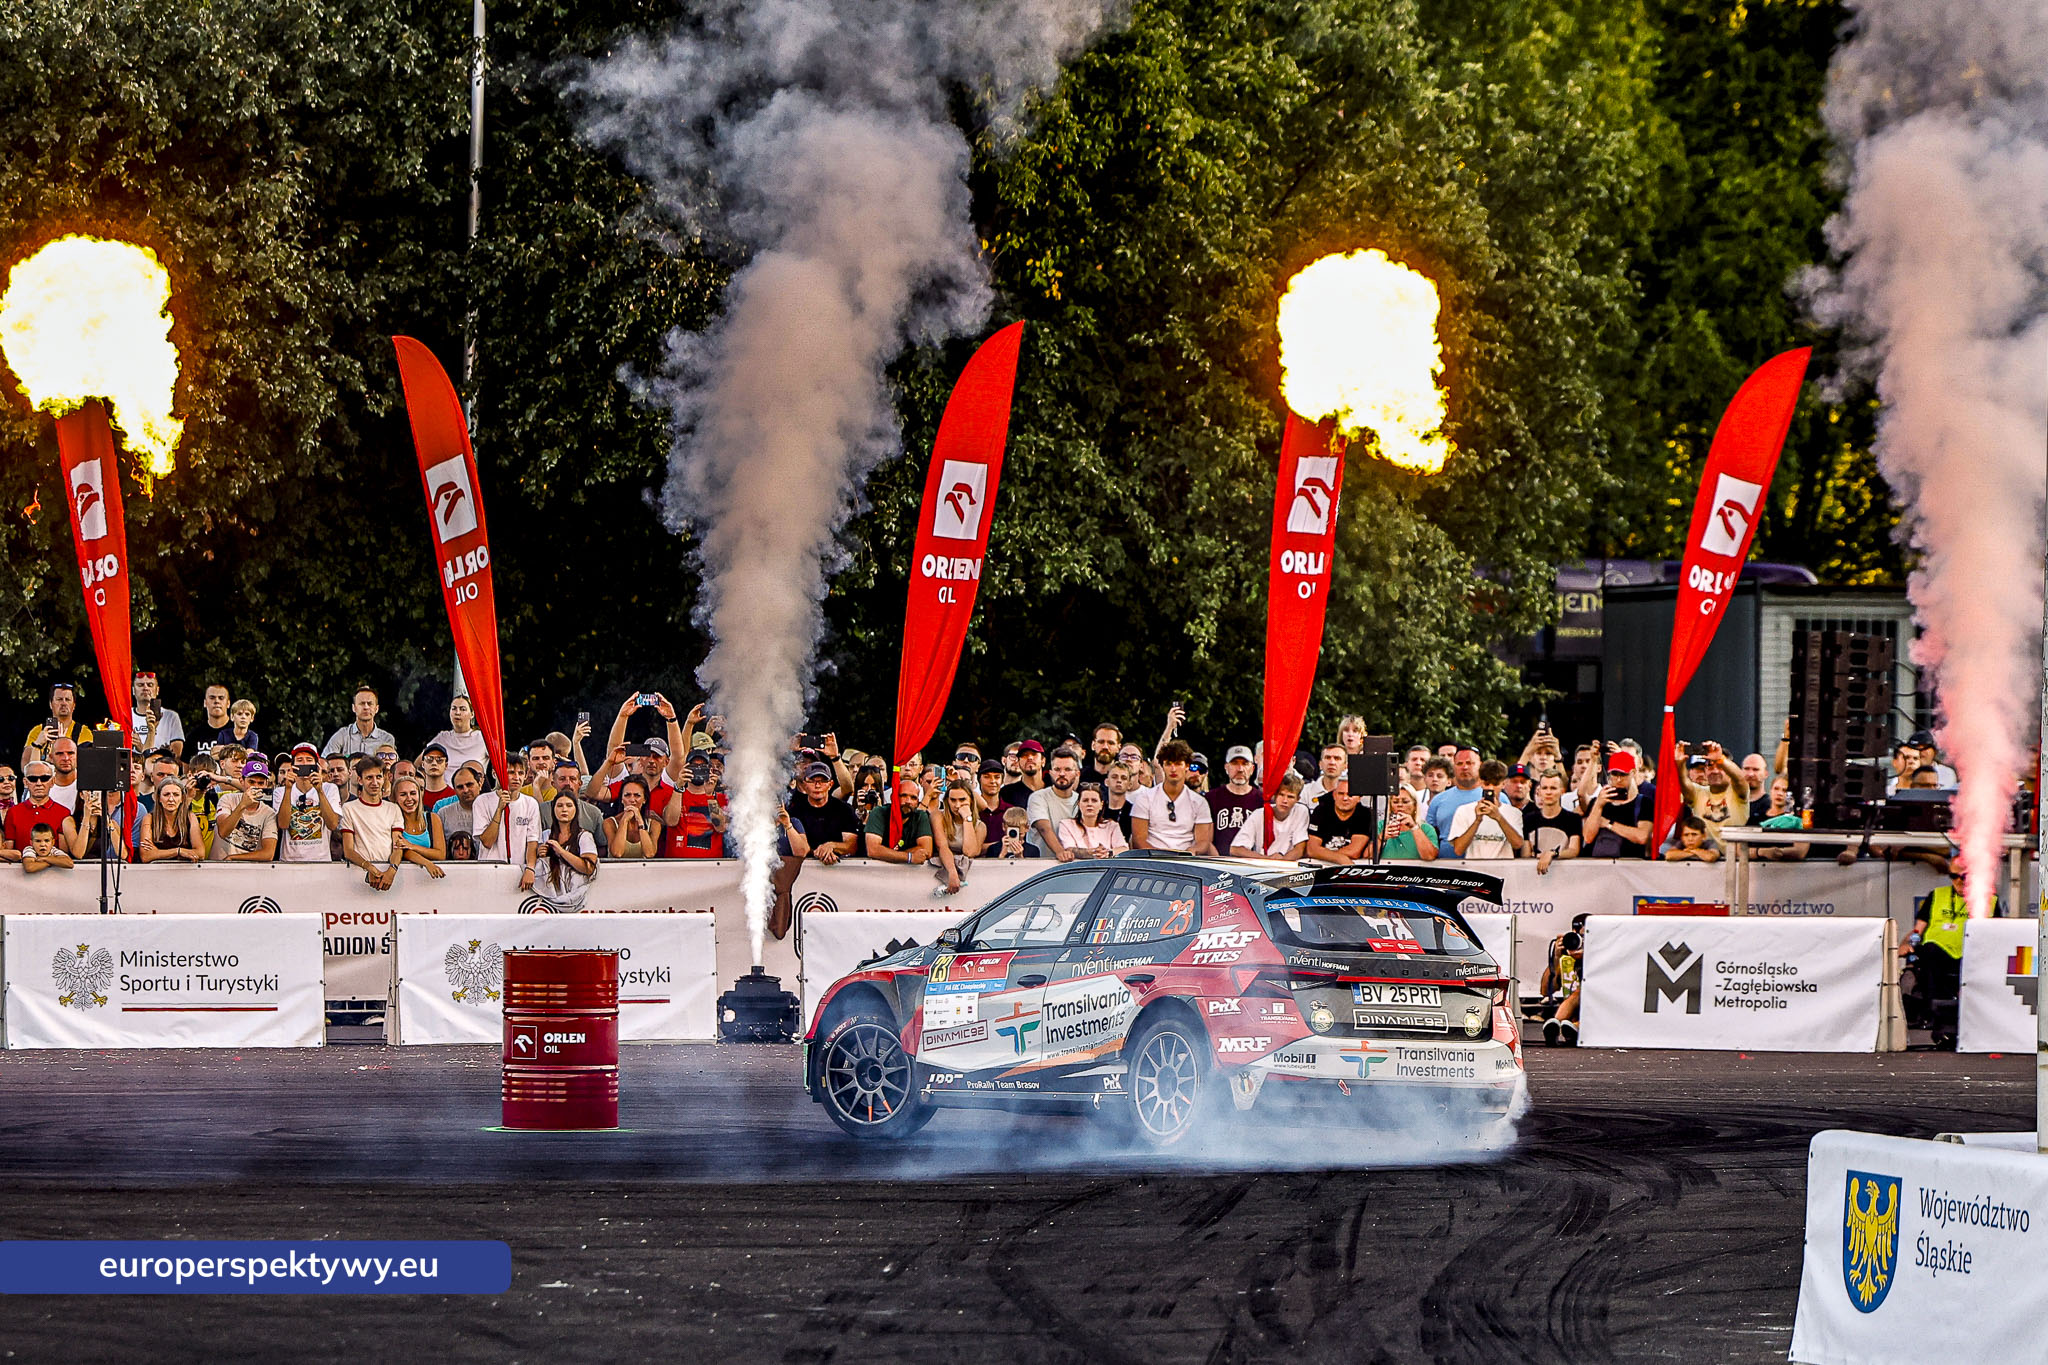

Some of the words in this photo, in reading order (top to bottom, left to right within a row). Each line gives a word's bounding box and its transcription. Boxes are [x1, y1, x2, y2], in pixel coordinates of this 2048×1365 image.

[1425, 877, 1450, 885] Team
[1451, 879, 1485, 888] Brasov
[1105, 919, 1115, 929] A.
[1160, 899, 1195, 935] 23
[324, 936, 376, 955] ADION
[1101, 931, 1111, 944] D.
[1189, 931, 1262, 951] MRF
[120, 950, 239, 968] Ministerstwo
[1113, 955, 1155, 970] HOFFMAN
[1192, 950, 1242, 965] TYRES
[931, 954, 953, 982] 23
[1321, 961, 1350, 972] HOFFMAN
[1715, 960, 1798, 979] Górnośląsko
[119, 974, 181, 994] Sportu
[186, 975, 190, 991] i
[195, 974, 279, 994] Turystyki
[618, 966, 671, 987] ystyki
[1360, 985, 1383, 1003] BV
[1043, 986, 1131, 1021] Transilvania
[1714, 995, 1788, 1012] Metropolia
[1046, 1010, 1126, 1044] Investments
[1359, 1015, 1444, 1027] DINAMIC92
[543, 1032, 586, 1044] ORLEN
[926, 1026, 986, 1045] DINAMIC92
[543, 1045, 561, 1054] OIL
[1217, 1036, 1272, 1053] MRF
[1273, 1053, 1304, 1064] Mobil
[1395, 1046, 1475, 1062] Transilvania
[1396, 1062, 1475, 1079] Investments
[966, 1080, 995, 1091] ProRally
[995, 1080, 1016, 1089] Team
[1015, 1080, 1040, 1089] Brasov
[1919, 1186, 2030, 1233] Województwo
[1915, 1230, 1973, 1278] Śląskie
